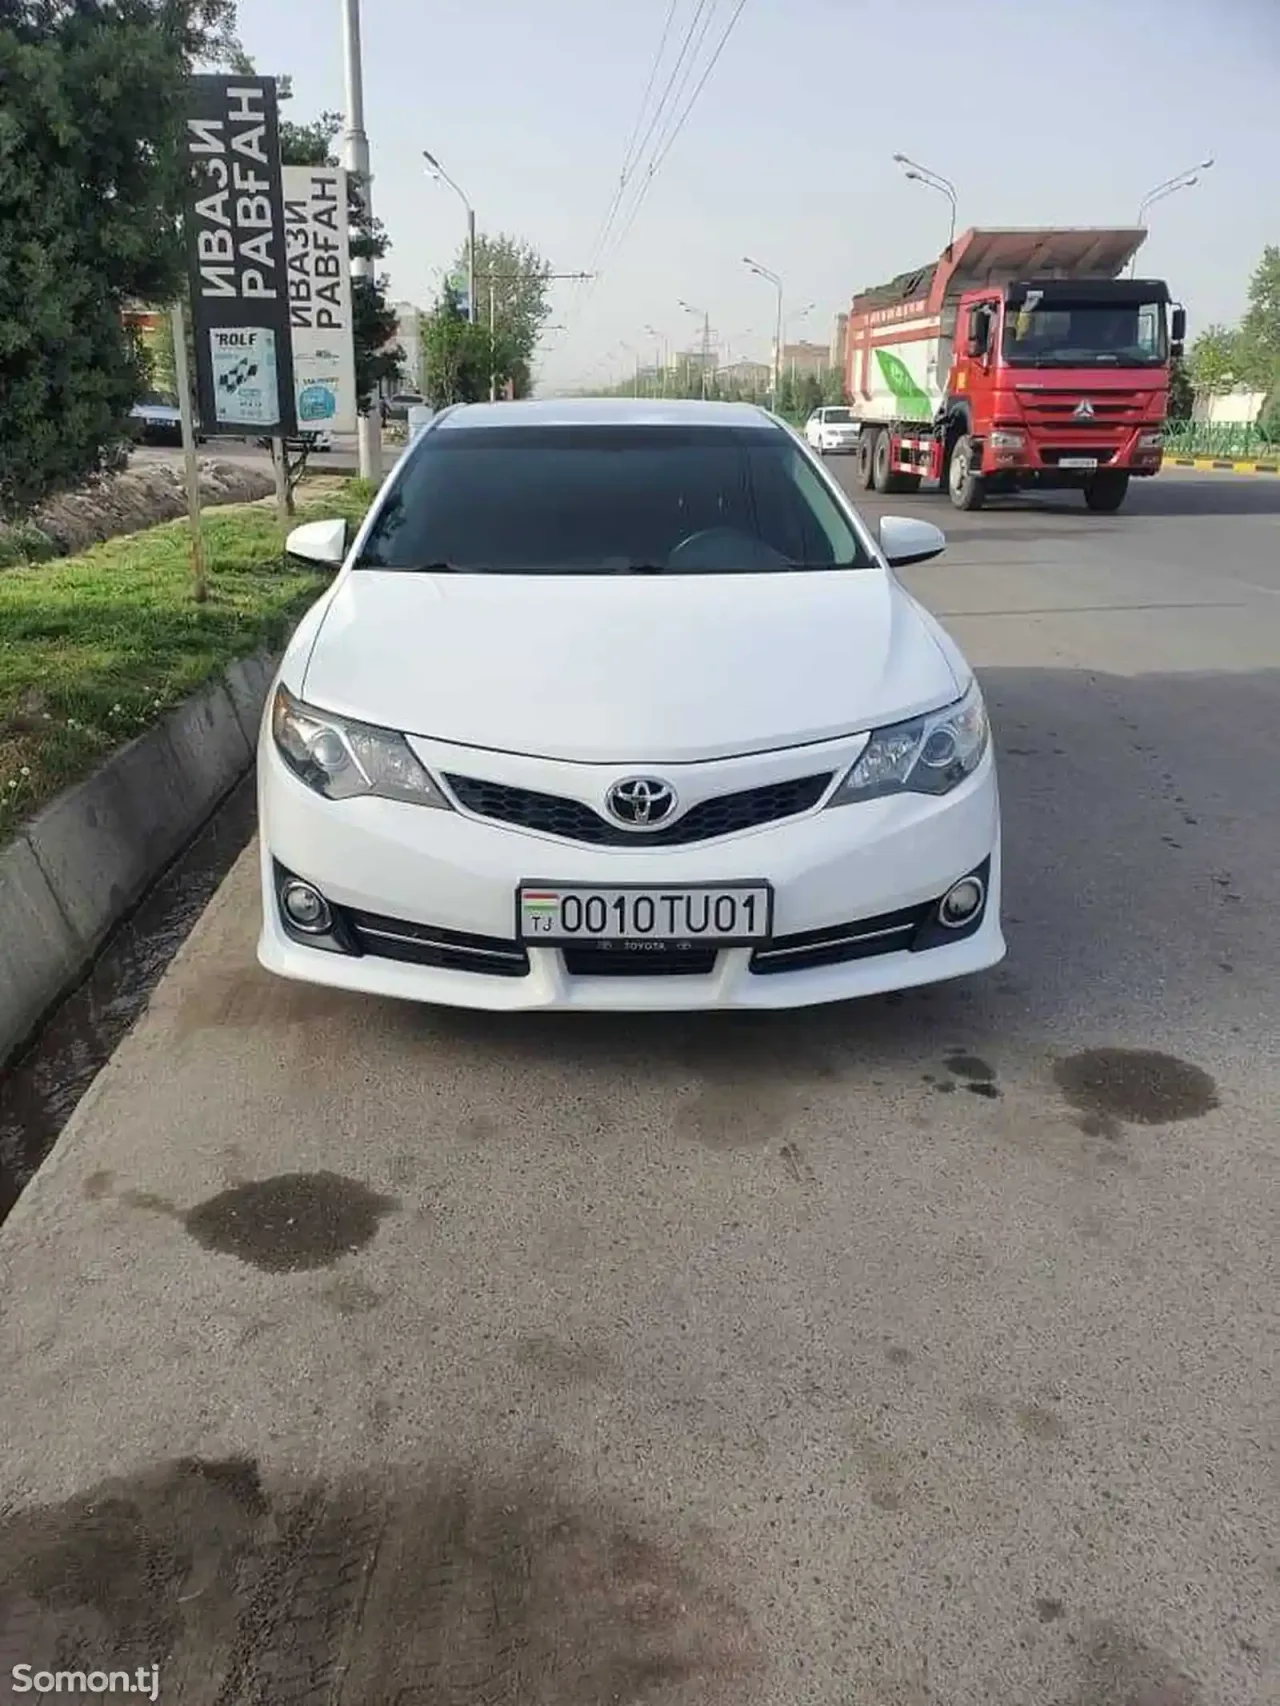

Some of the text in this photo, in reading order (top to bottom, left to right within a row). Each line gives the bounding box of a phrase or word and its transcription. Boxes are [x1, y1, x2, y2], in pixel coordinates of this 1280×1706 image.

[187, 119, 237, 297] ИВАЗИ
[226, 87, 277, 298] РАВҒАН
[284, 200, 312, 328] ИВАЗИ
[311, 177, 342, 329] РАВҒАН
[218, 333, 257, 346] ROLF
[531, 916, 553, 932] TJ
[560, 895, 756, 934] 0010TU01
[623, 941, 667, 951] TOYOTA
